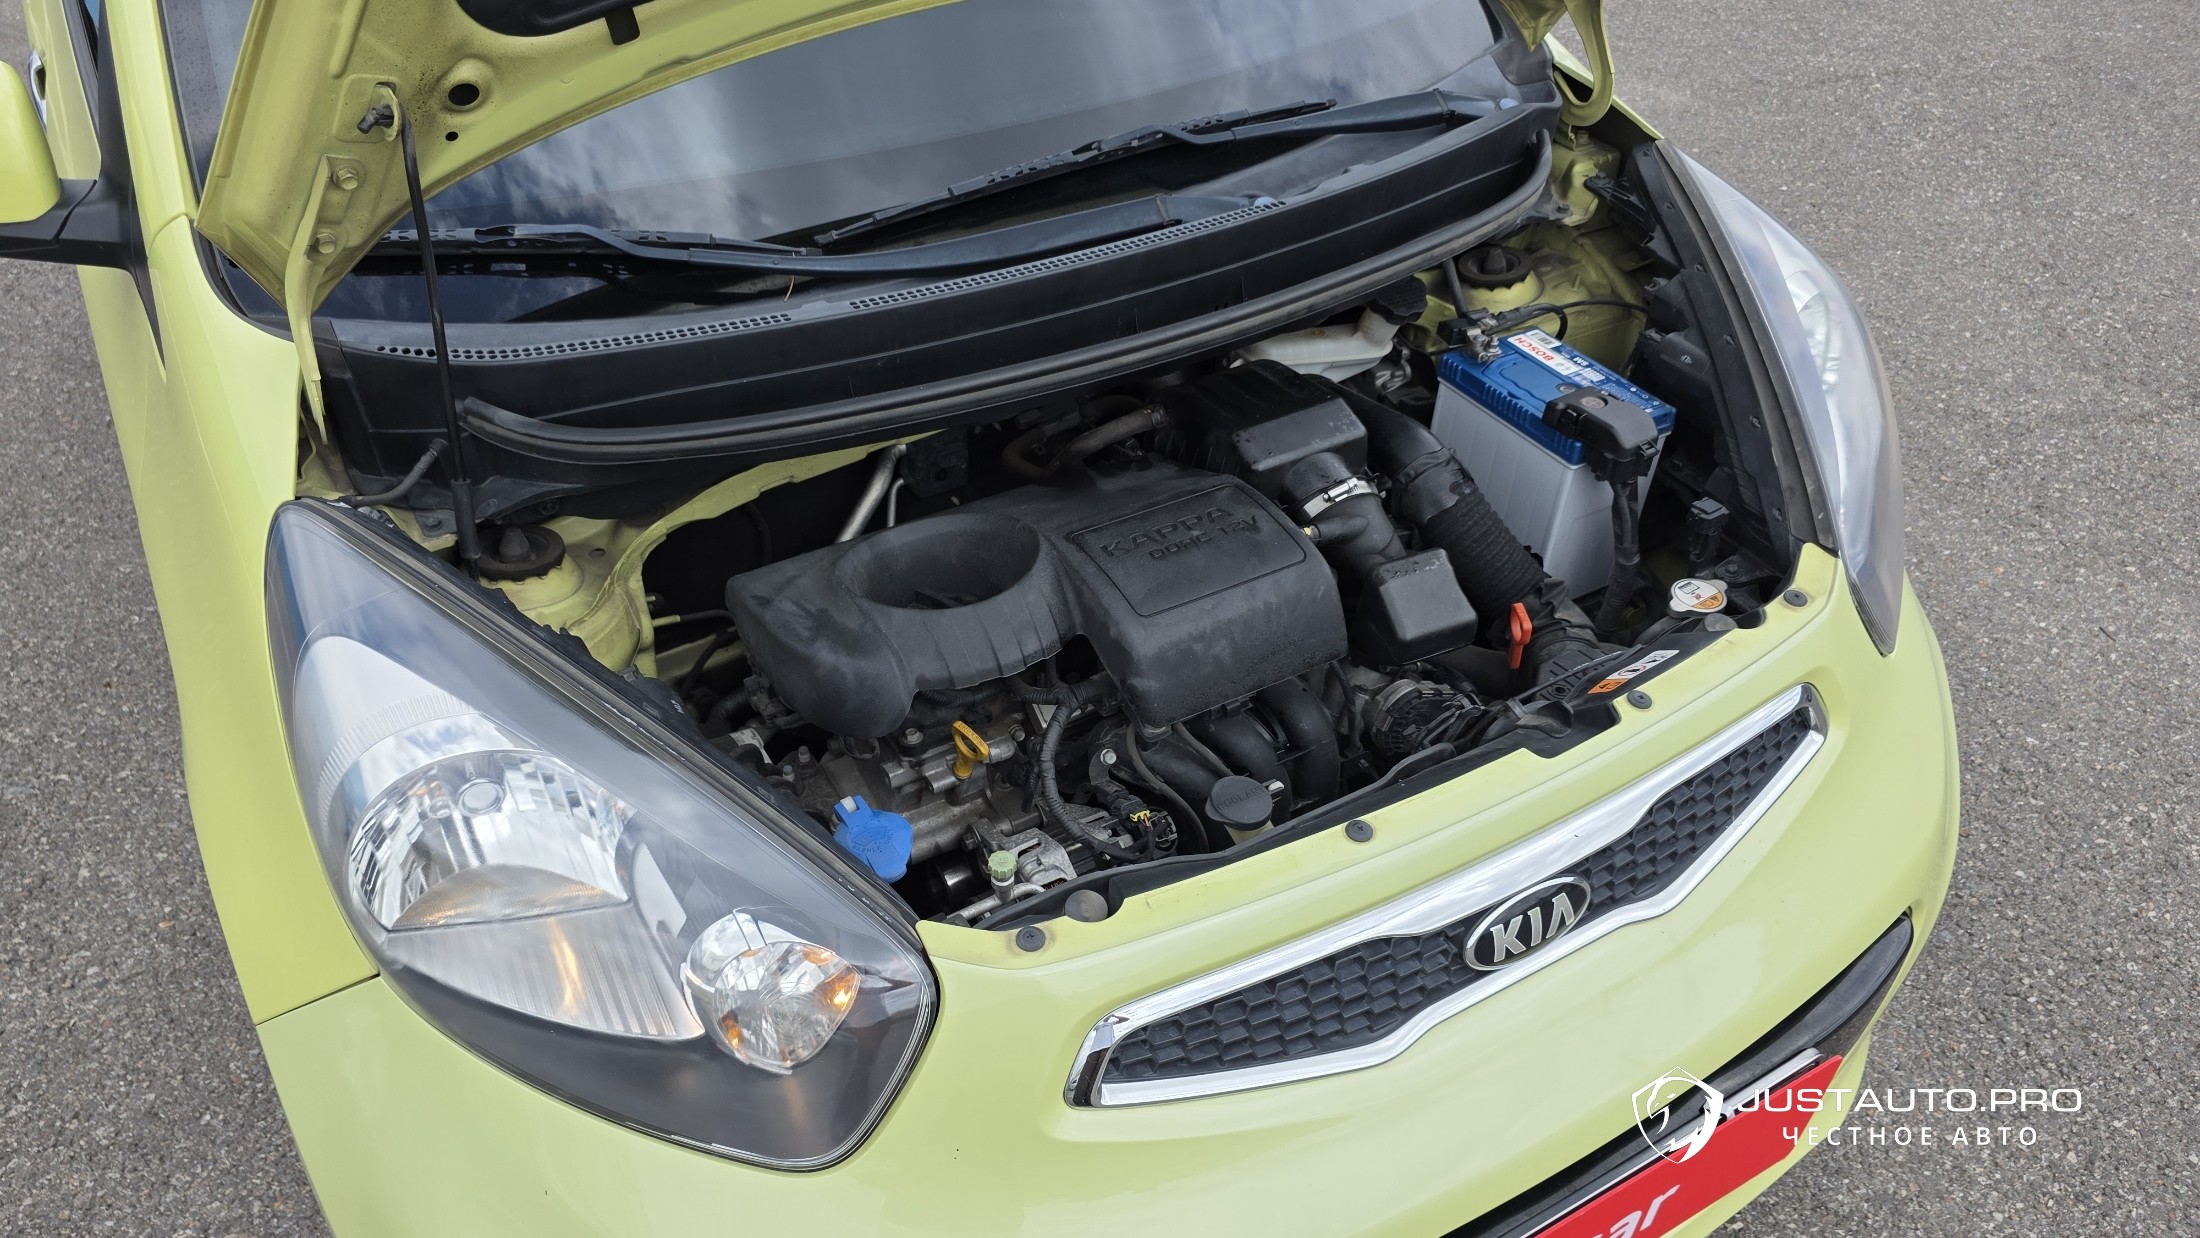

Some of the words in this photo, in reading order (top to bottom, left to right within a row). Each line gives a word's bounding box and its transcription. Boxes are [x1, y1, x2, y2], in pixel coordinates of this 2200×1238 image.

[1514, 337, 1555, 362] BOSCH
[1100, 506, 1235, 557] KAPPA
[1147, 532, 1212, 560] DOHC
[1216, 515, 1262, 535] 12V
[1217, 785, 1267, 811] COOLANT
[1489, 892, 1575, 963] KIA
[1591, 1184, 1681, 1238] ar
